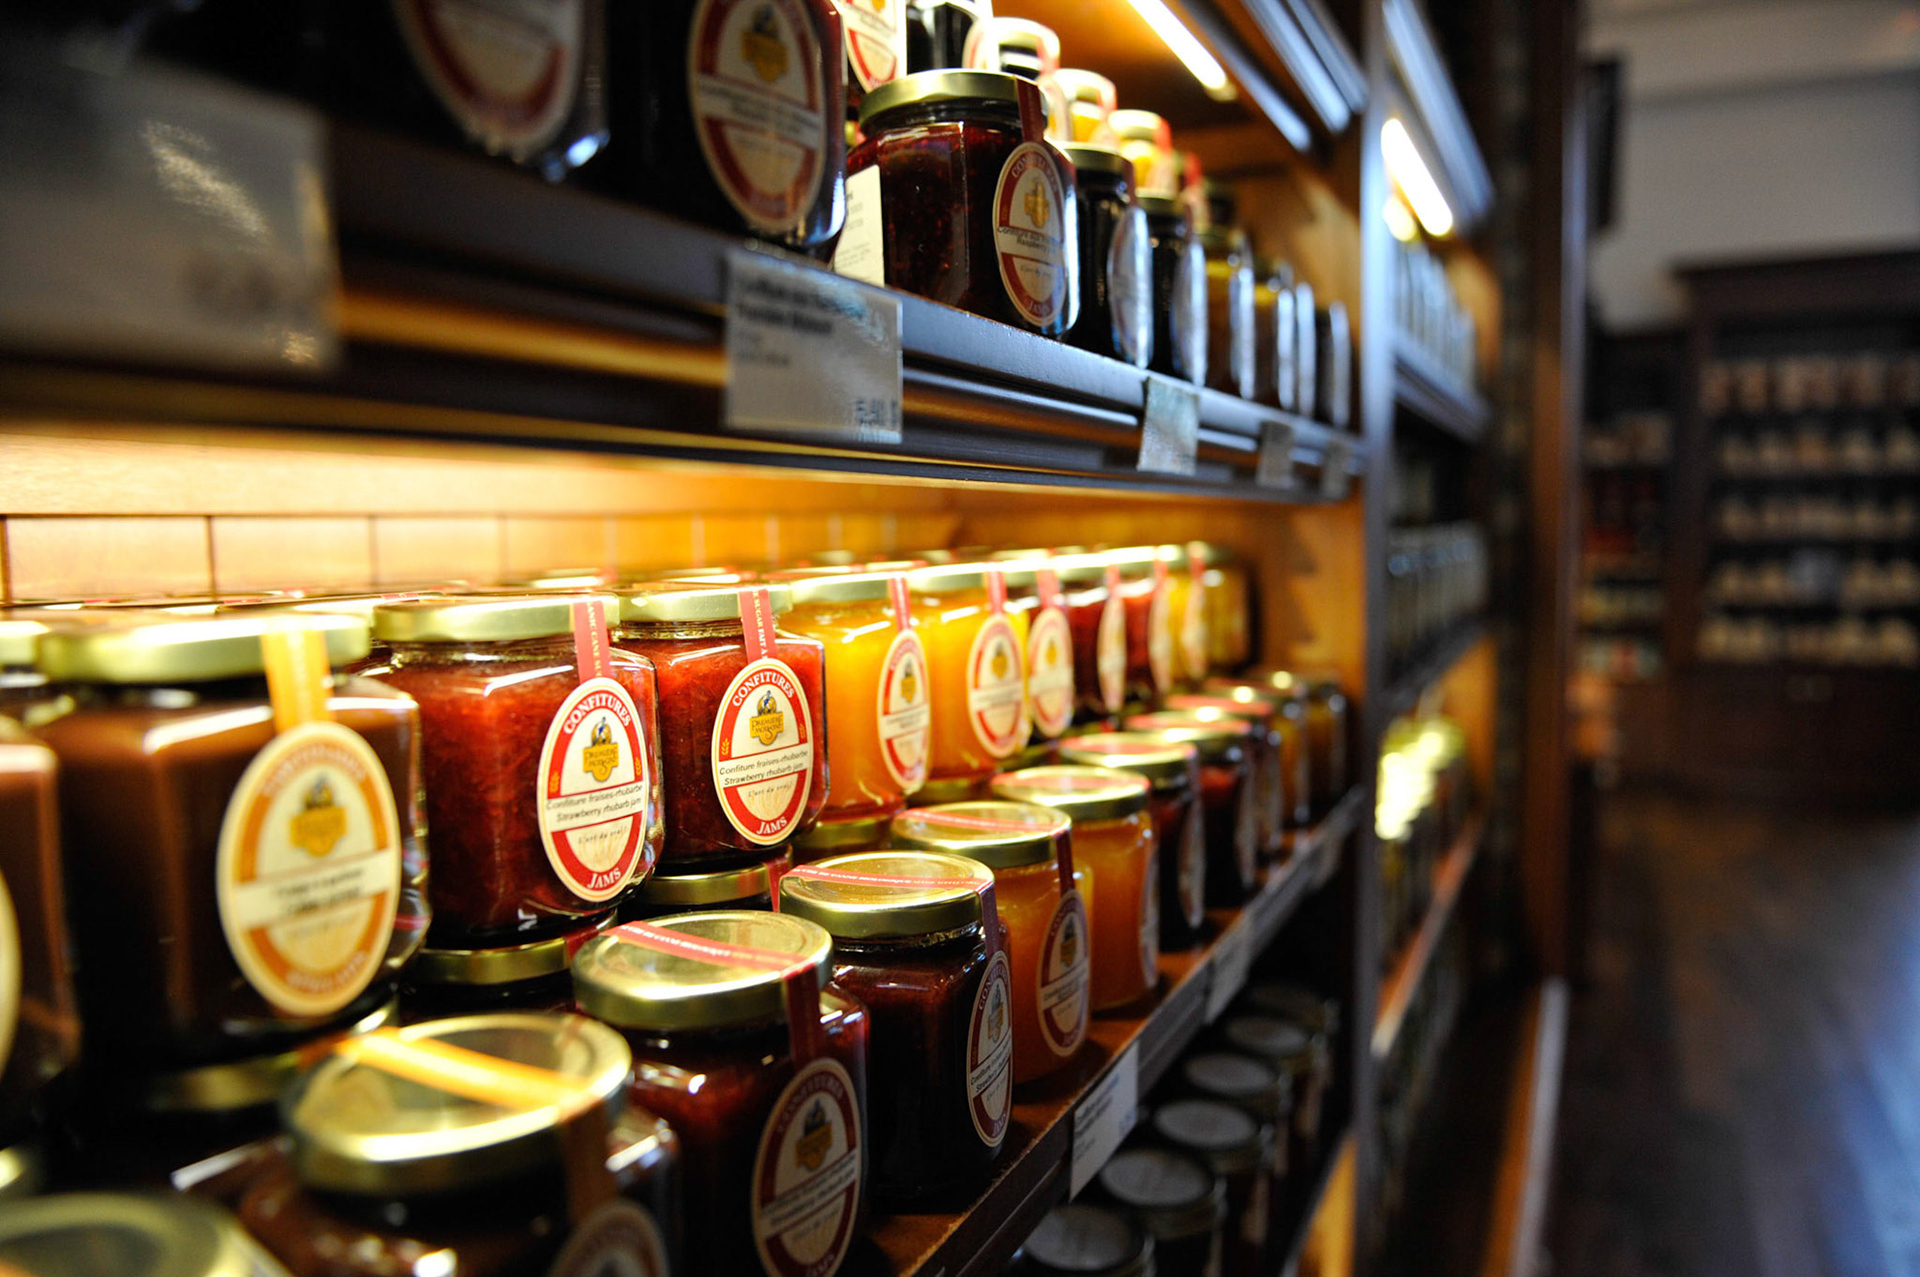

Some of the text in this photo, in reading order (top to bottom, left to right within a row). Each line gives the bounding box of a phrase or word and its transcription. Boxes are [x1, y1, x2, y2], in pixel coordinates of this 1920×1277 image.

[758, 628, 767, 648] FAIT
[732, 671, 795, 707] CONFITURES
[563, 694, 631, 735] CONFITURES
[719, 750, 808, 776] Confiture fraises-rhubarbe
[724, 771, 765, 786] Strawberry
[766, 763, 792, 778] rhubarb
[547, 796, 587, 811] Confiture
[557, 806, 601, 823] Strawberry
[603, 800, 630, 814] rhubarb
[756, 816, 788, 835] JAMS
[587, 867, 621, 890] JAMS
